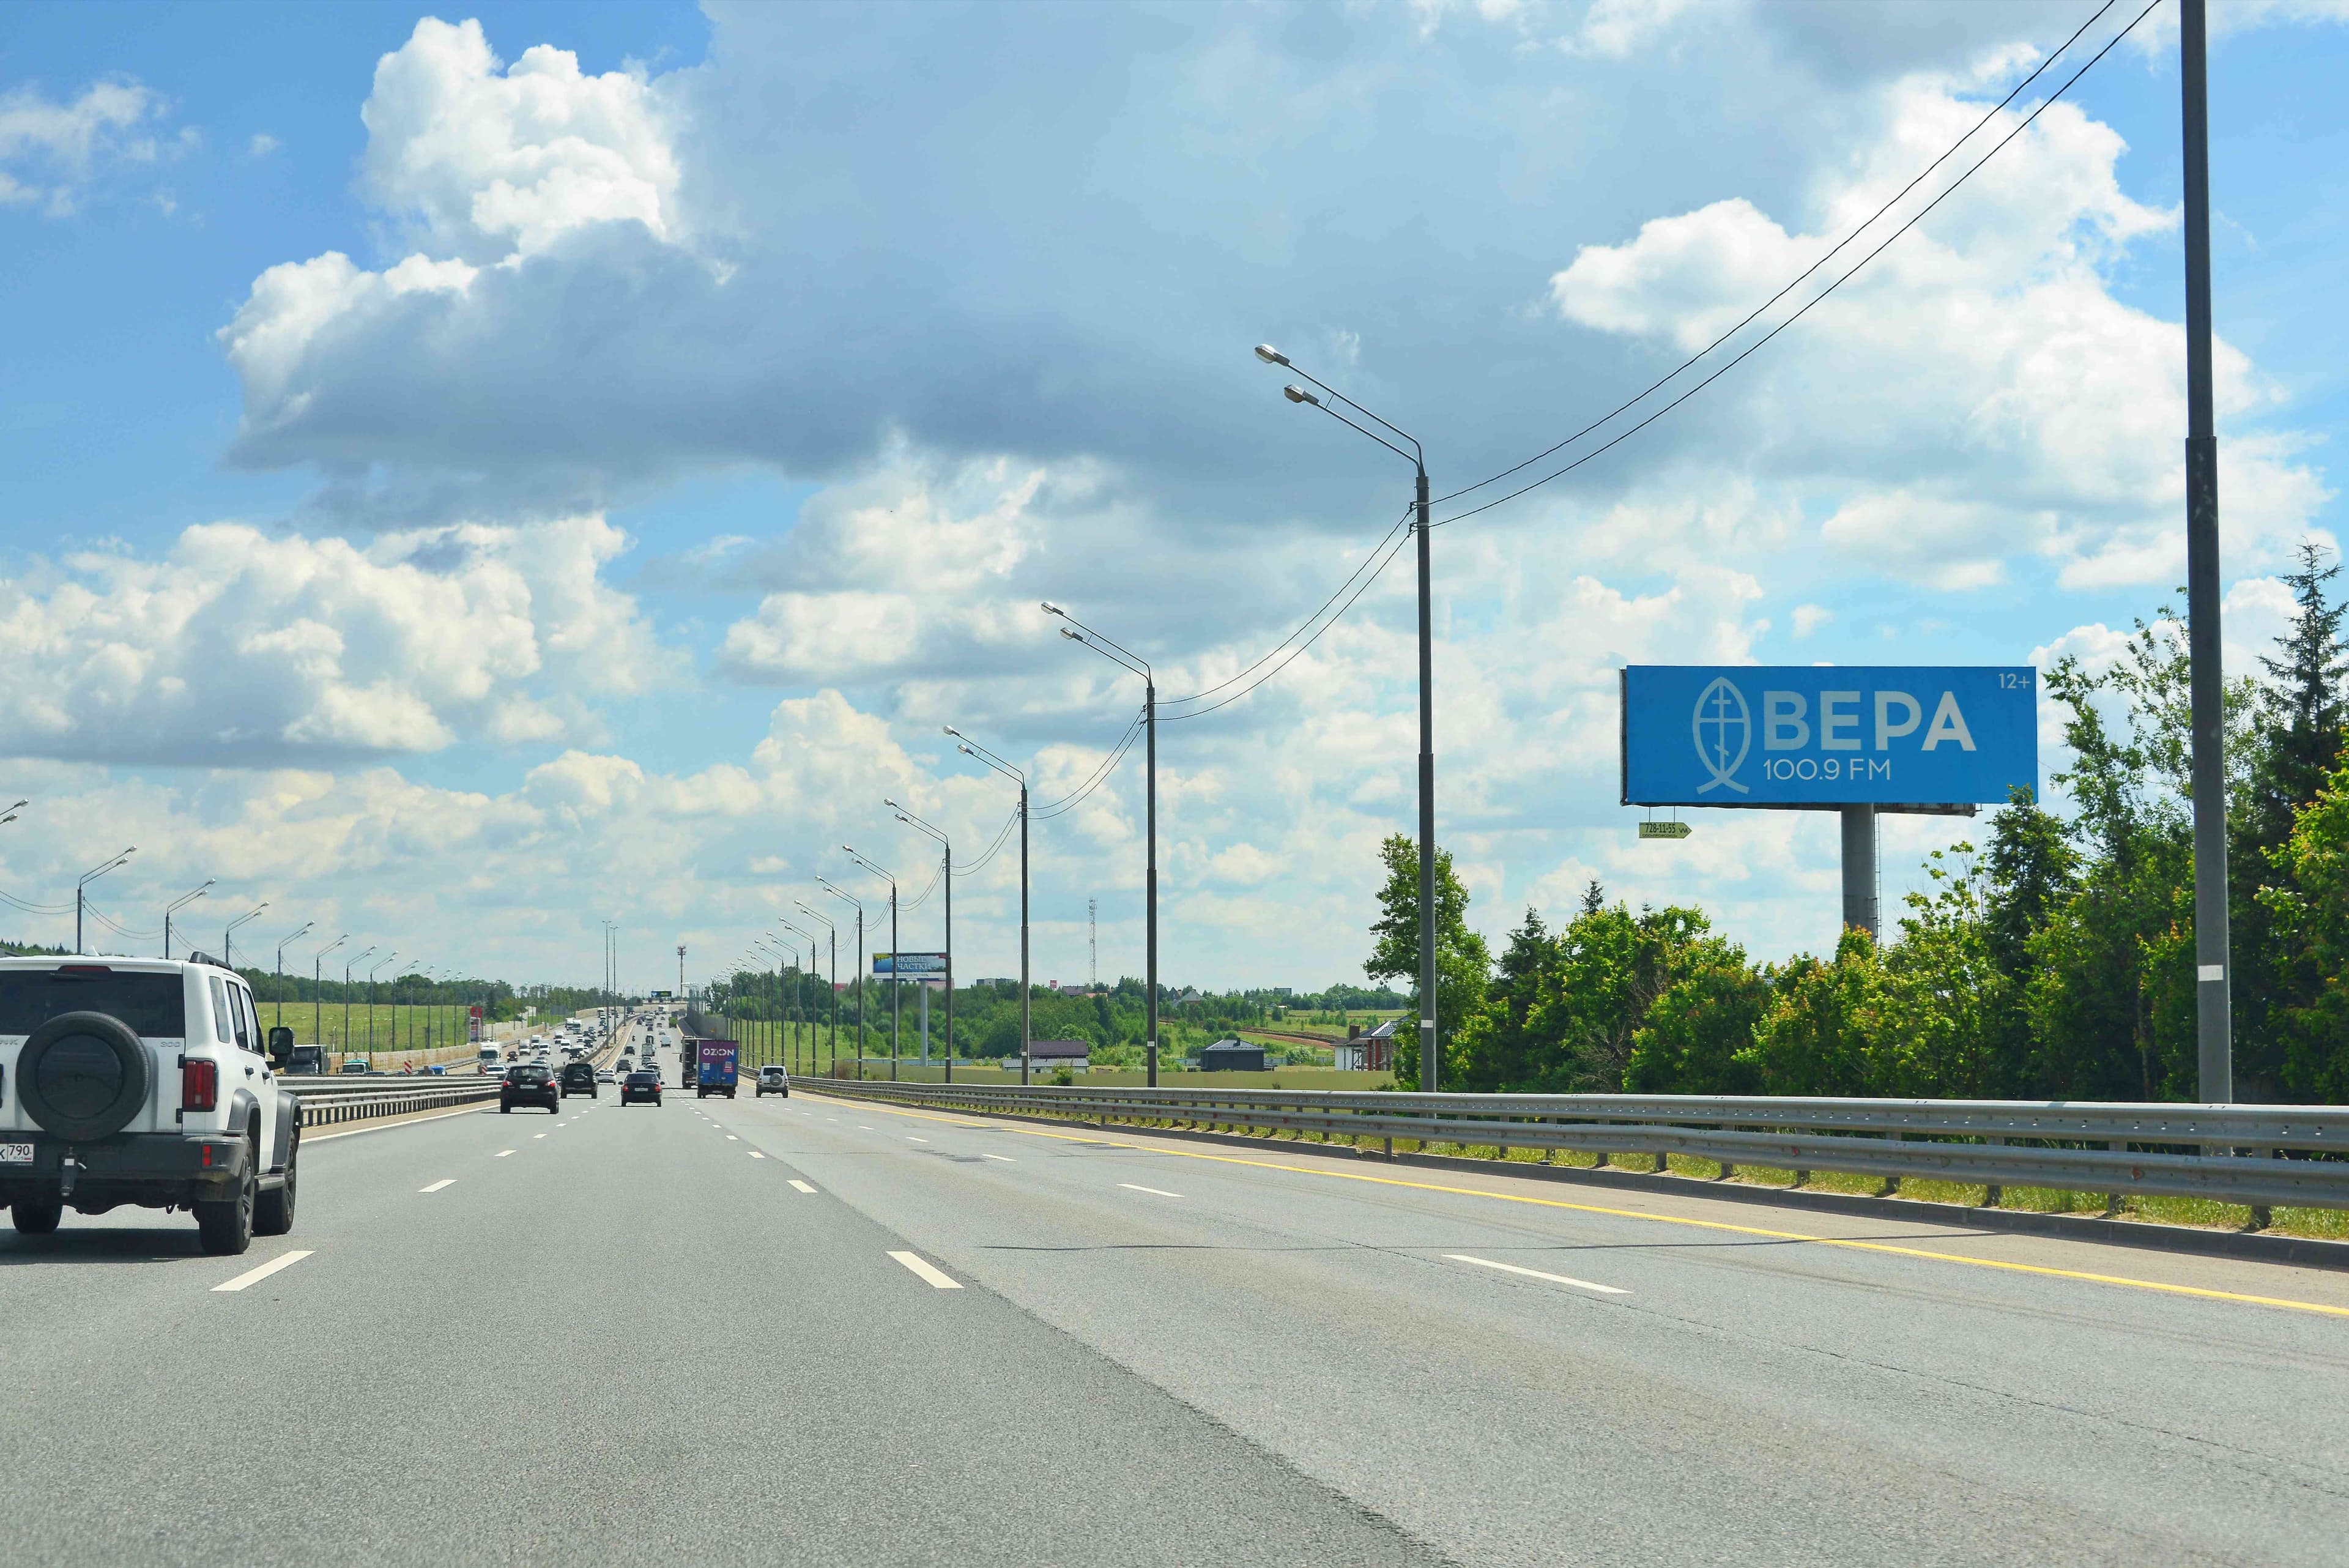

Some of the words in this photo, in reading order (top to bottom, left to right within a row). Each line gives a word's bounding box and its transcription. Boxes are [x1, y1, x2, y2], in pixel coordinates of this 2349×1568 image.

[1998, 673, 2030, 689] 12+
[1764, 691, 1976, 751] ВЕРА
[1763, 759, 1839, 780] 100.9
[1850, 759, 1890, 780] FM
[1646, 823, 1675, 833] 728-11-55
[703, 1048, 735, 1057] OZON
[9, 1145, 29, 1156] 790
